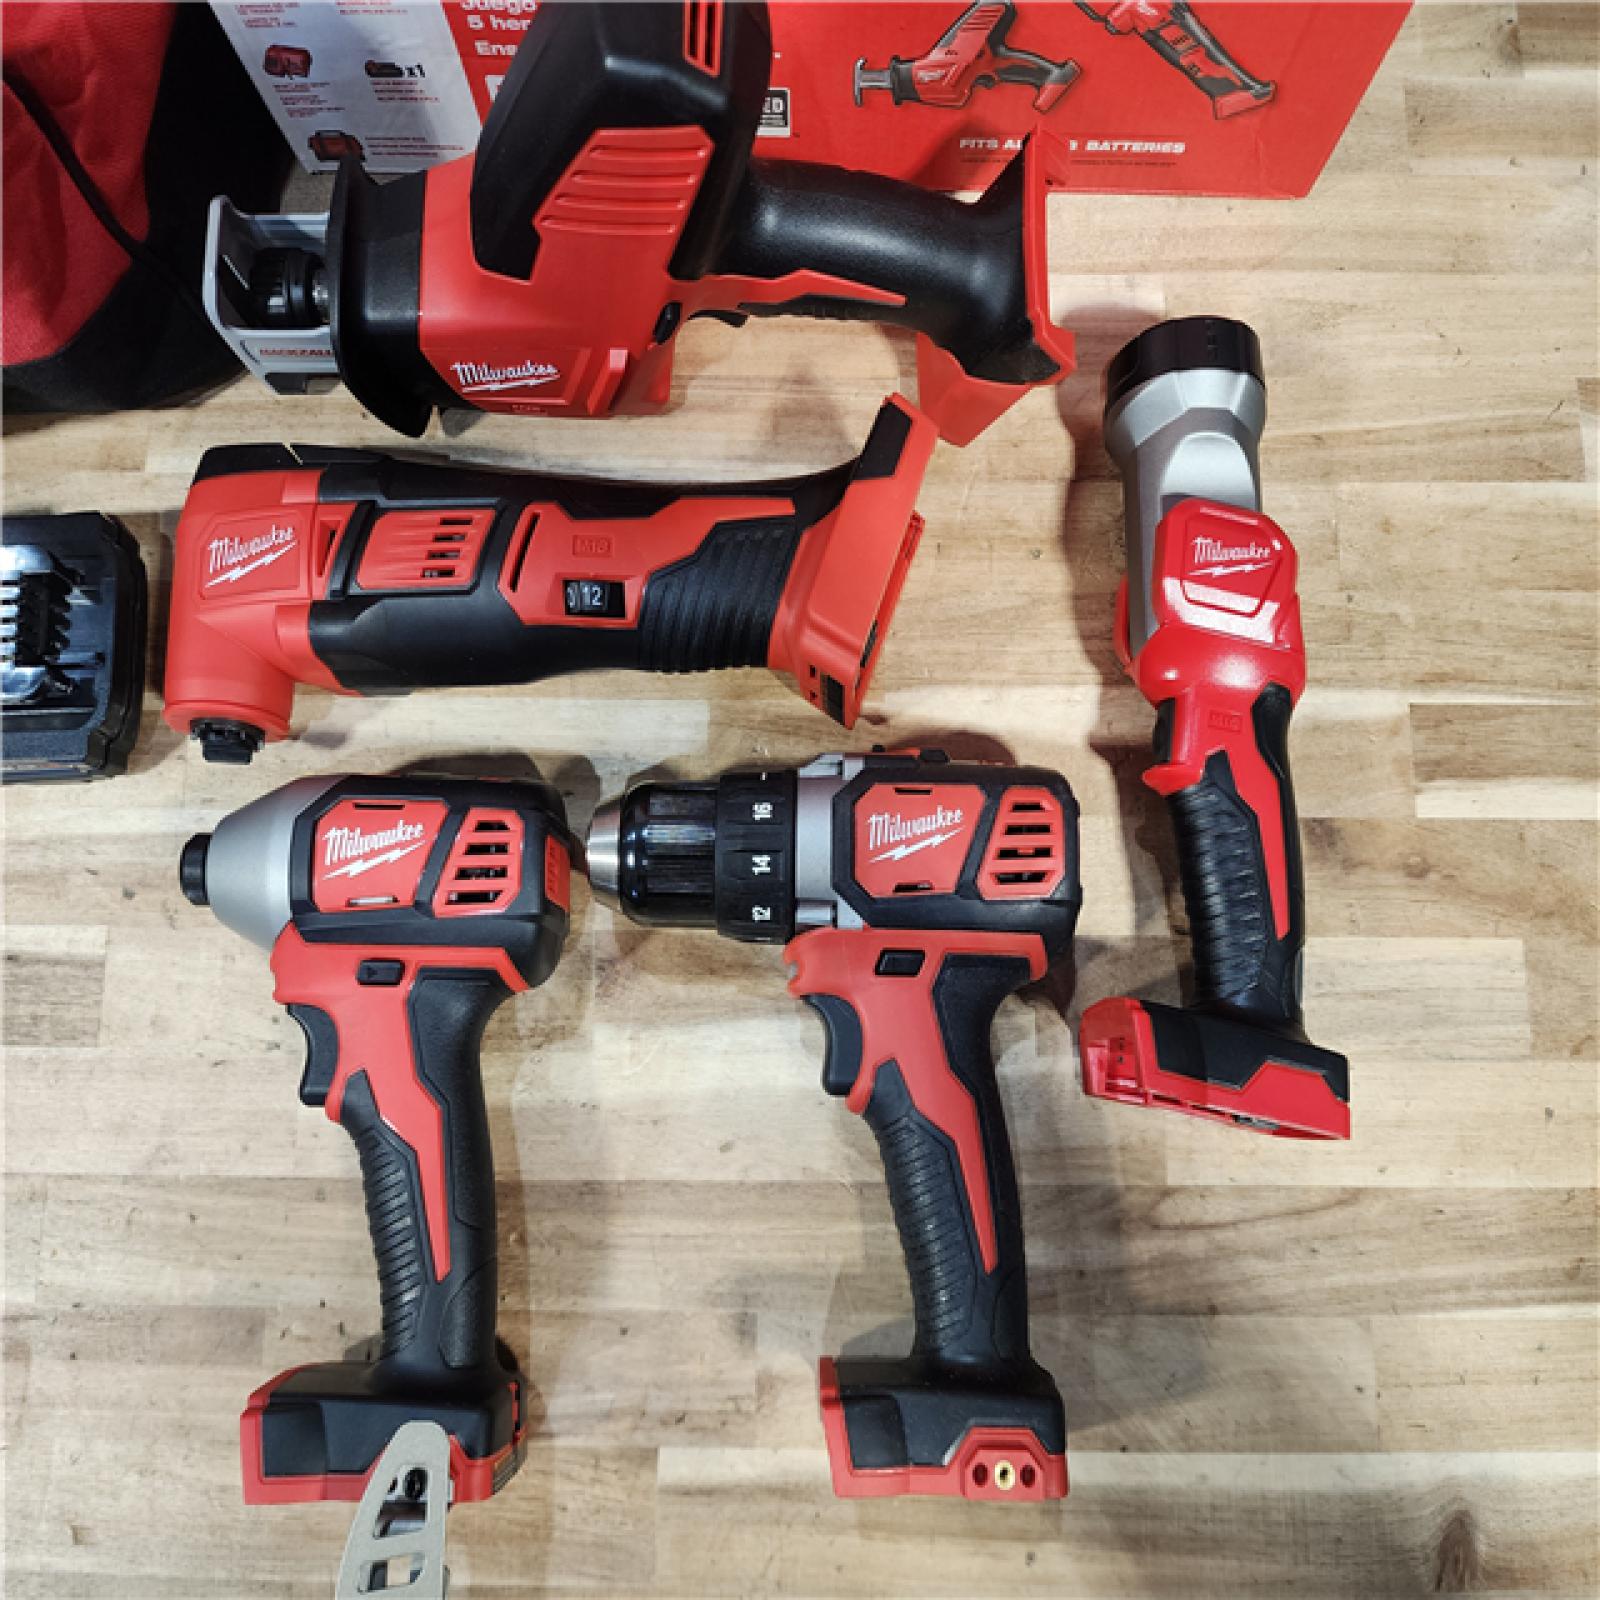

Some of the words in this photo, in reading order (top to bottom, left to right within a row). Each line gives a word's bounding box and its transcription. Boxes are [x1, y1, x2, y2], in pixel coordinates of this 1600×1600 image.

[489, 14, 531, 31] her
[959, 139, 998, 149] FITS
[1004, 139, 1023, 150] AL
[1085, 140, 1186, 153] BATTERIES
[450, 360, 559, 386] Milwaukee
[207, 524, 294, 575] Milwaukee
[1192, 535, 1271, 564] Milwaukee
[583, 584, 603, 606] 12
[866, 805, 963, 850] Milwaukee
[322, 820, 424, 866] Milwaukee
[751, 855, 771, 875] 14
